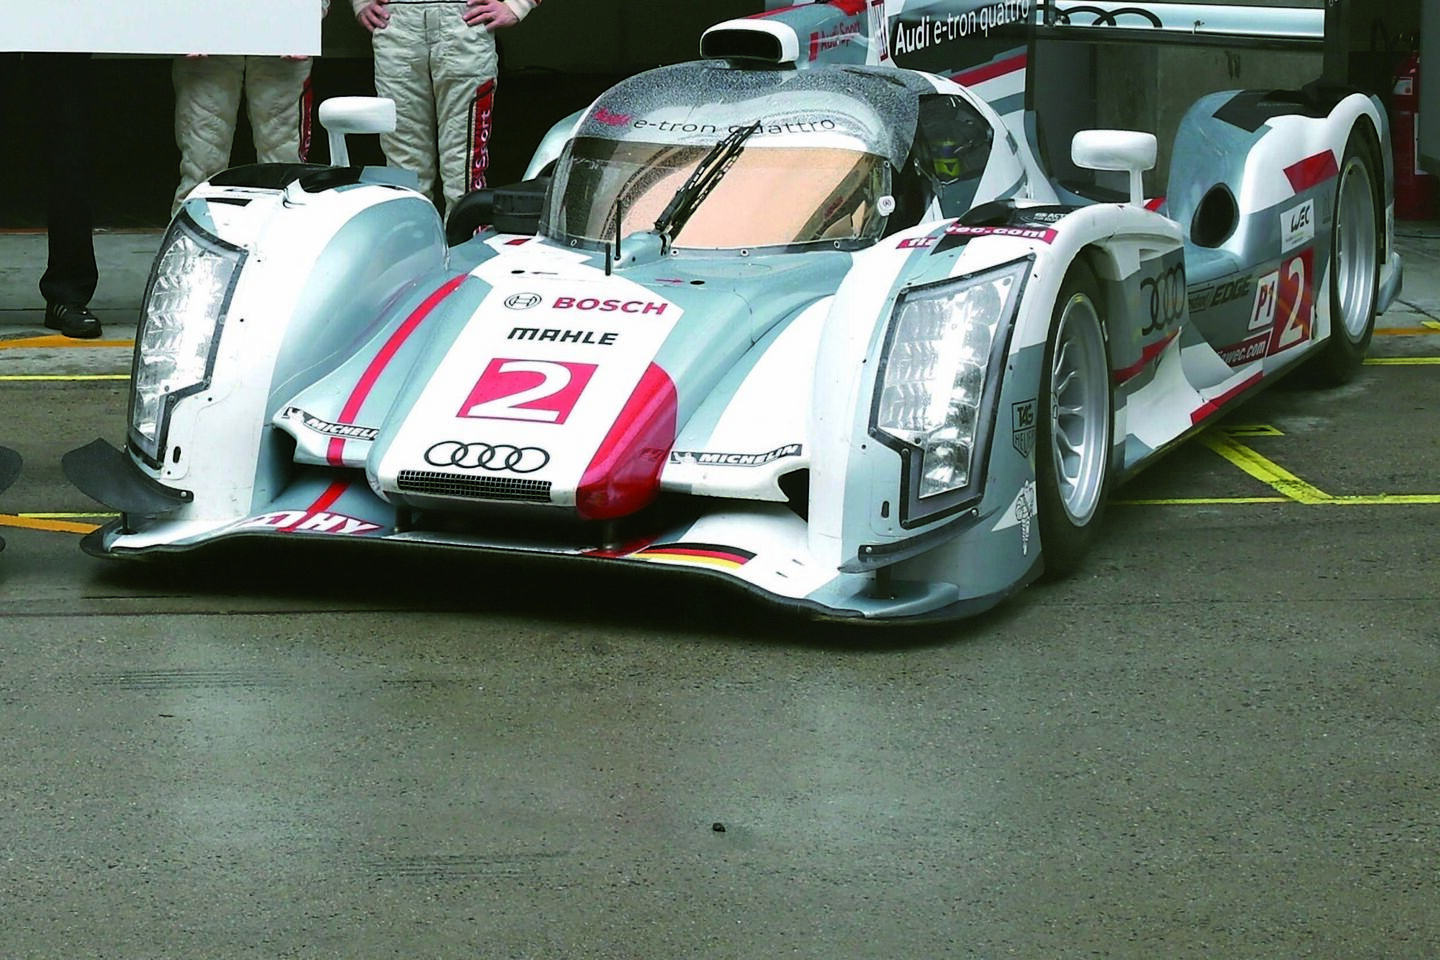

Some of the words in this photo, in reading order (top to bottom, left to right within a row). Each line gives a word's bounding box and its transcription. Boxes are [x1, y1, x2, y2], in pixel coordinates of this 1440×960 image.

[894, 14, 931, 56] Audi
[934, 8, 976, 45] e-tron
[633, 119, 717, 134] e-tron
[552, 296, 668, 315] BOSCH
[1254, 280, 1276, 322] P1
[1278, 256, 1304, 349] 2
[507, 327, 619, 346] MAHLE
[1218, 340, 1266, 363] awec.com
[466, 359, 572, 423] 2
[307, 417, 378, 439] MICHELI
[699, 444, 799, 464] MICHELIN
[296, 511, 381, 534] HY
